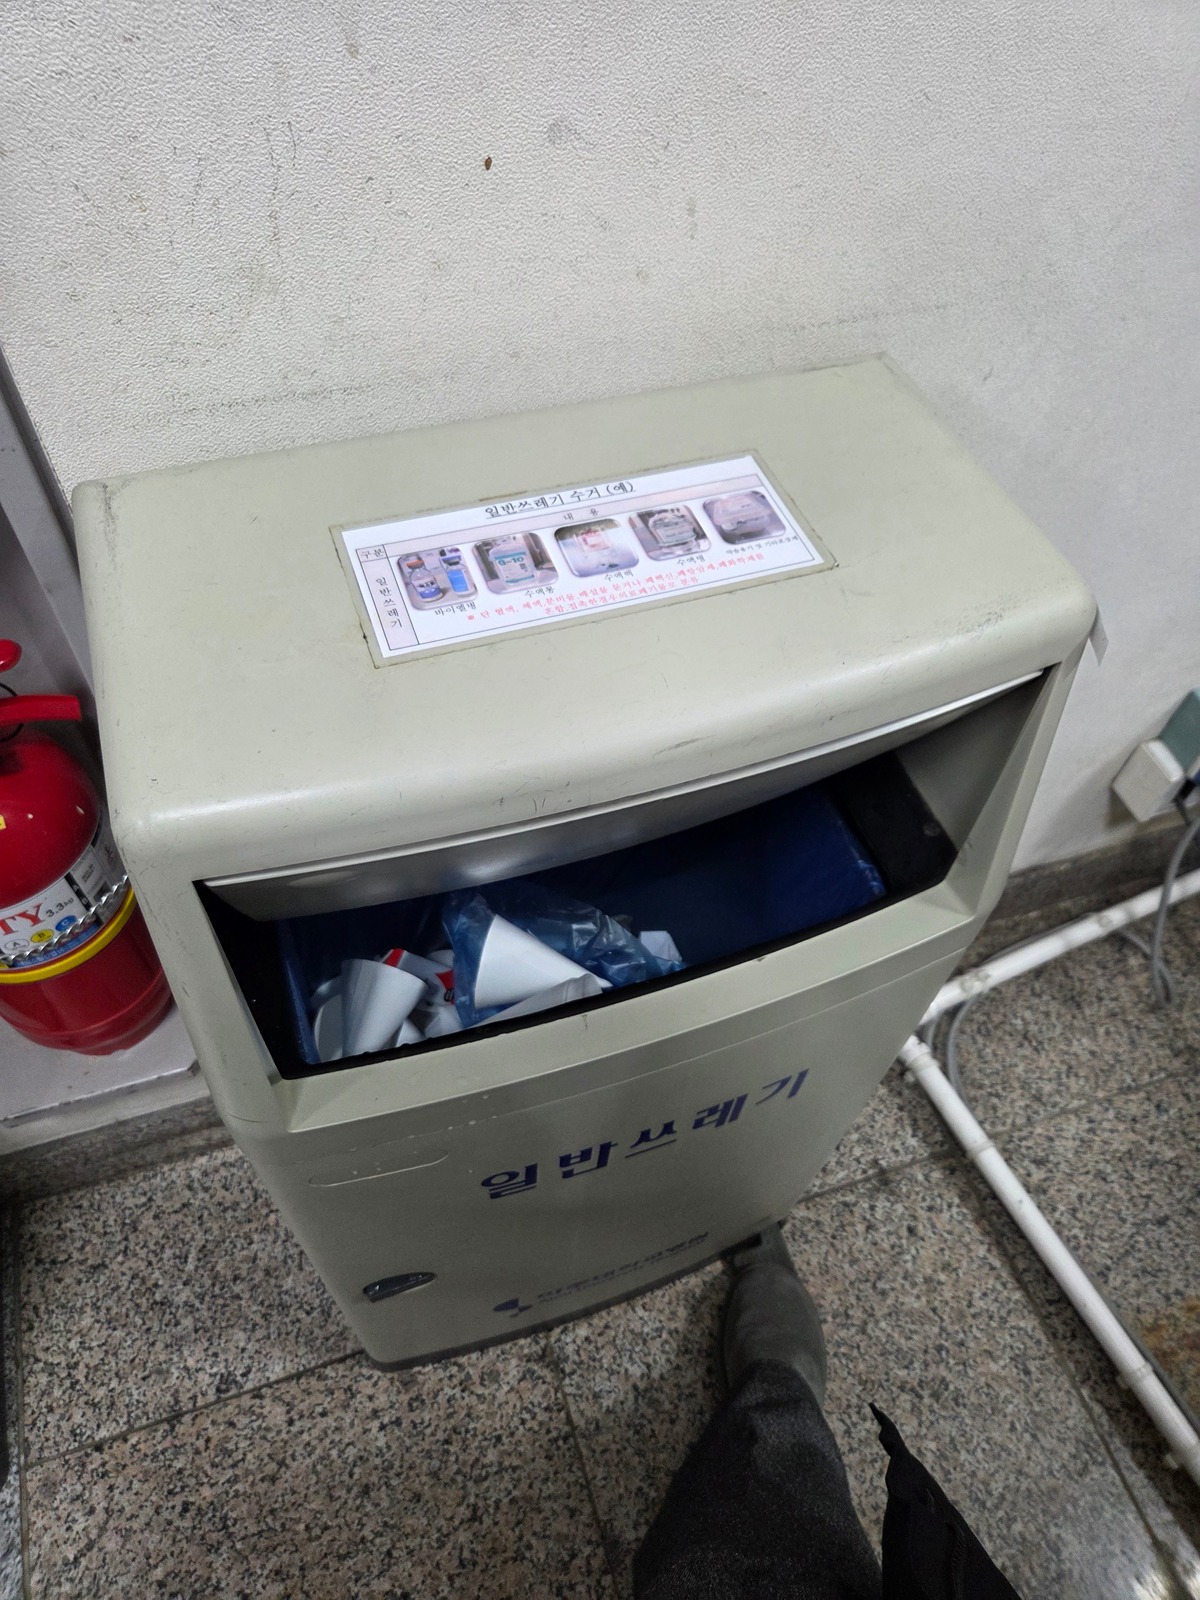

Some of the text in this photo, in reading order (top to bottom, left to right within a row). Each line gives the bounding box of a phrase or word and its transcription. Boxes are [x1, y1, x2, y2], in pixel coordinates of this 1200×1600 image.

[485, 481, 635, 519] 일반쓰레기 수거 (예)
[361, 548, 383, 559] 구분
[376, 576, 402, 628] 일반쓰레기
[480, 1068, 810, 1200] 일반쓰레기
